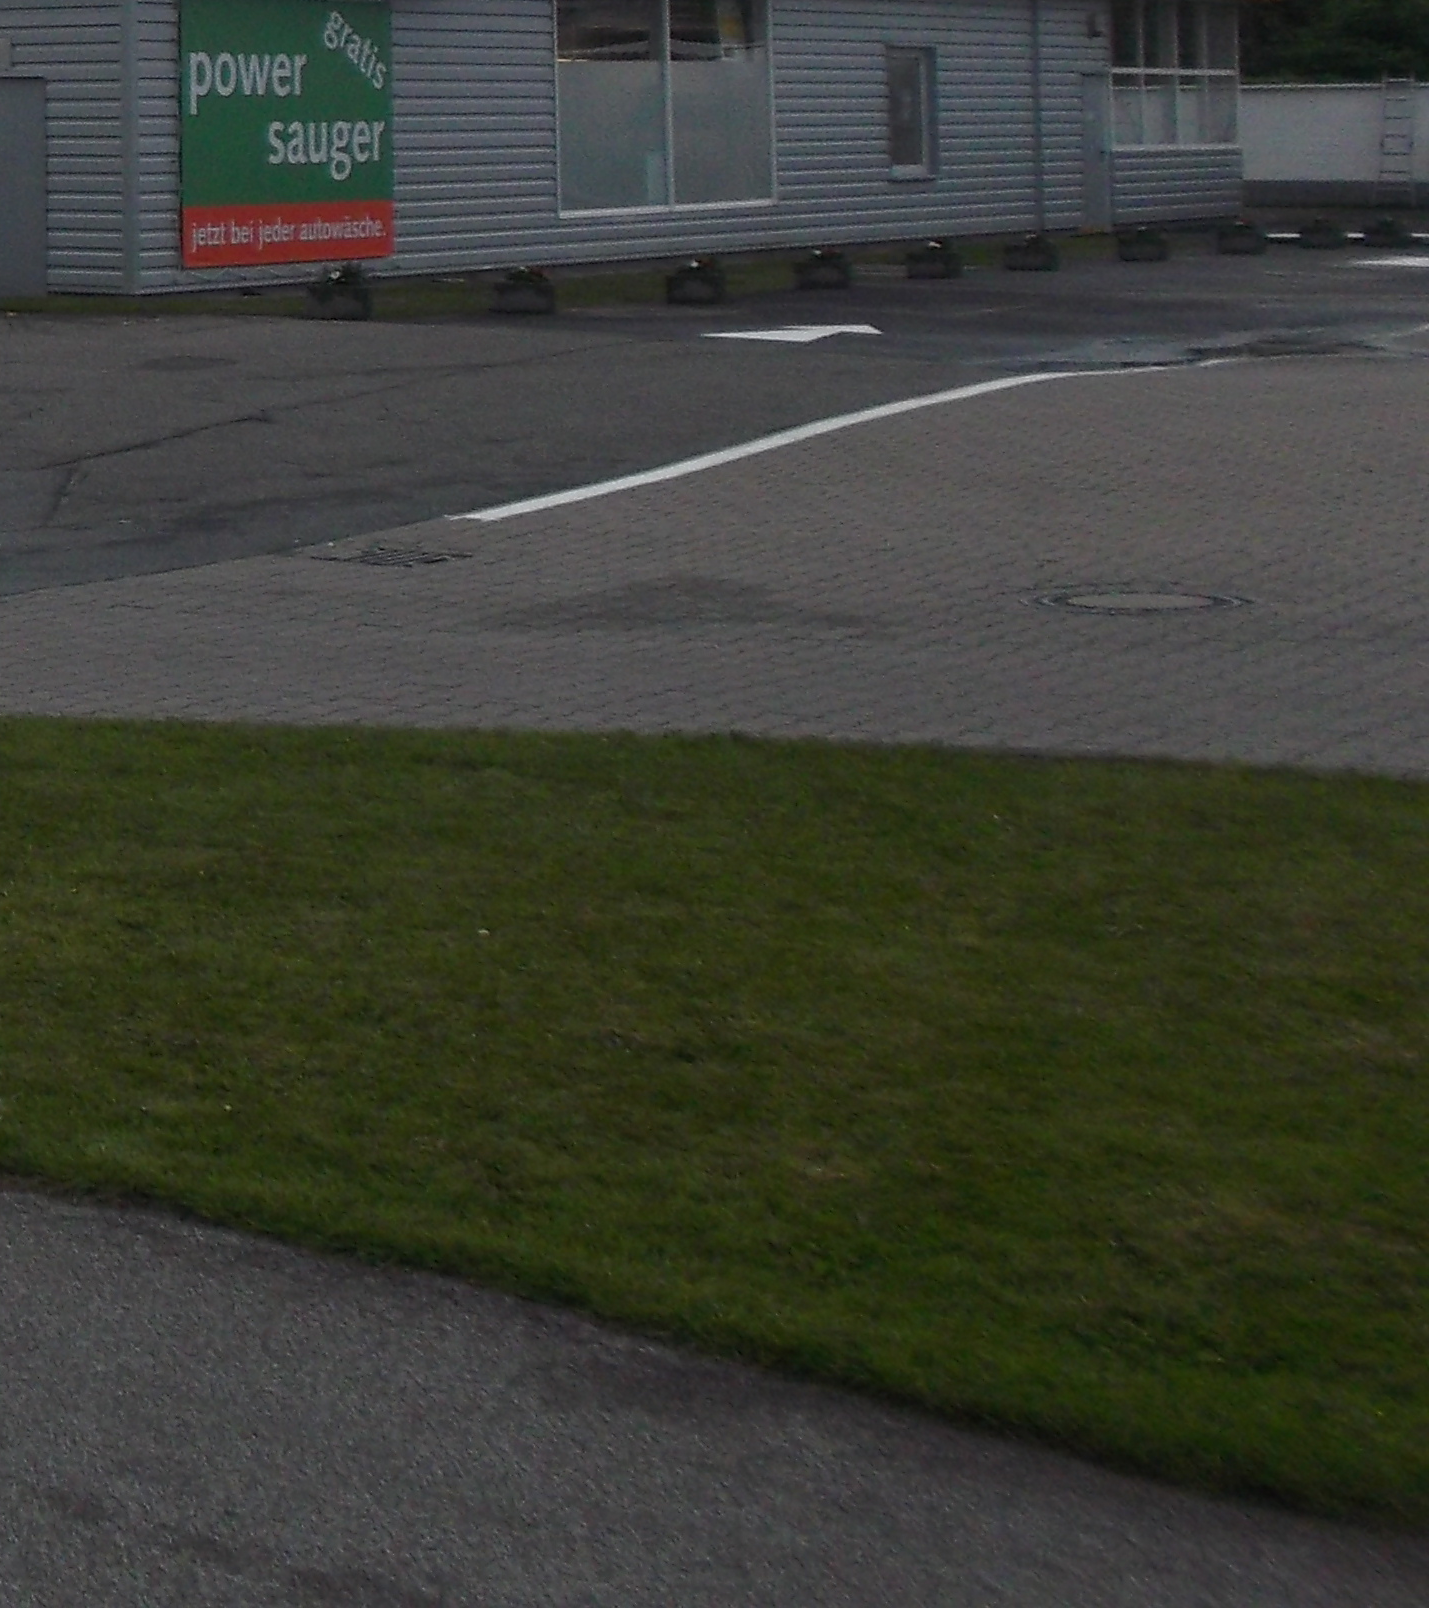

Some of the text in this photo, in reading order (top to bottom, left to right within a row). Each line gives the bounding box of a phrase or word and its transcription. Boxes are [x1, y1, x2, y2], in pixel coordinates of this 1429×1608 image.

[323, 9, 388, 91] gratis
[189, 51, 308, 116] power
[267, 120, 386, 182] sauger
[192, 213, 387, 254] jetzt bei jeder autowäsche.
